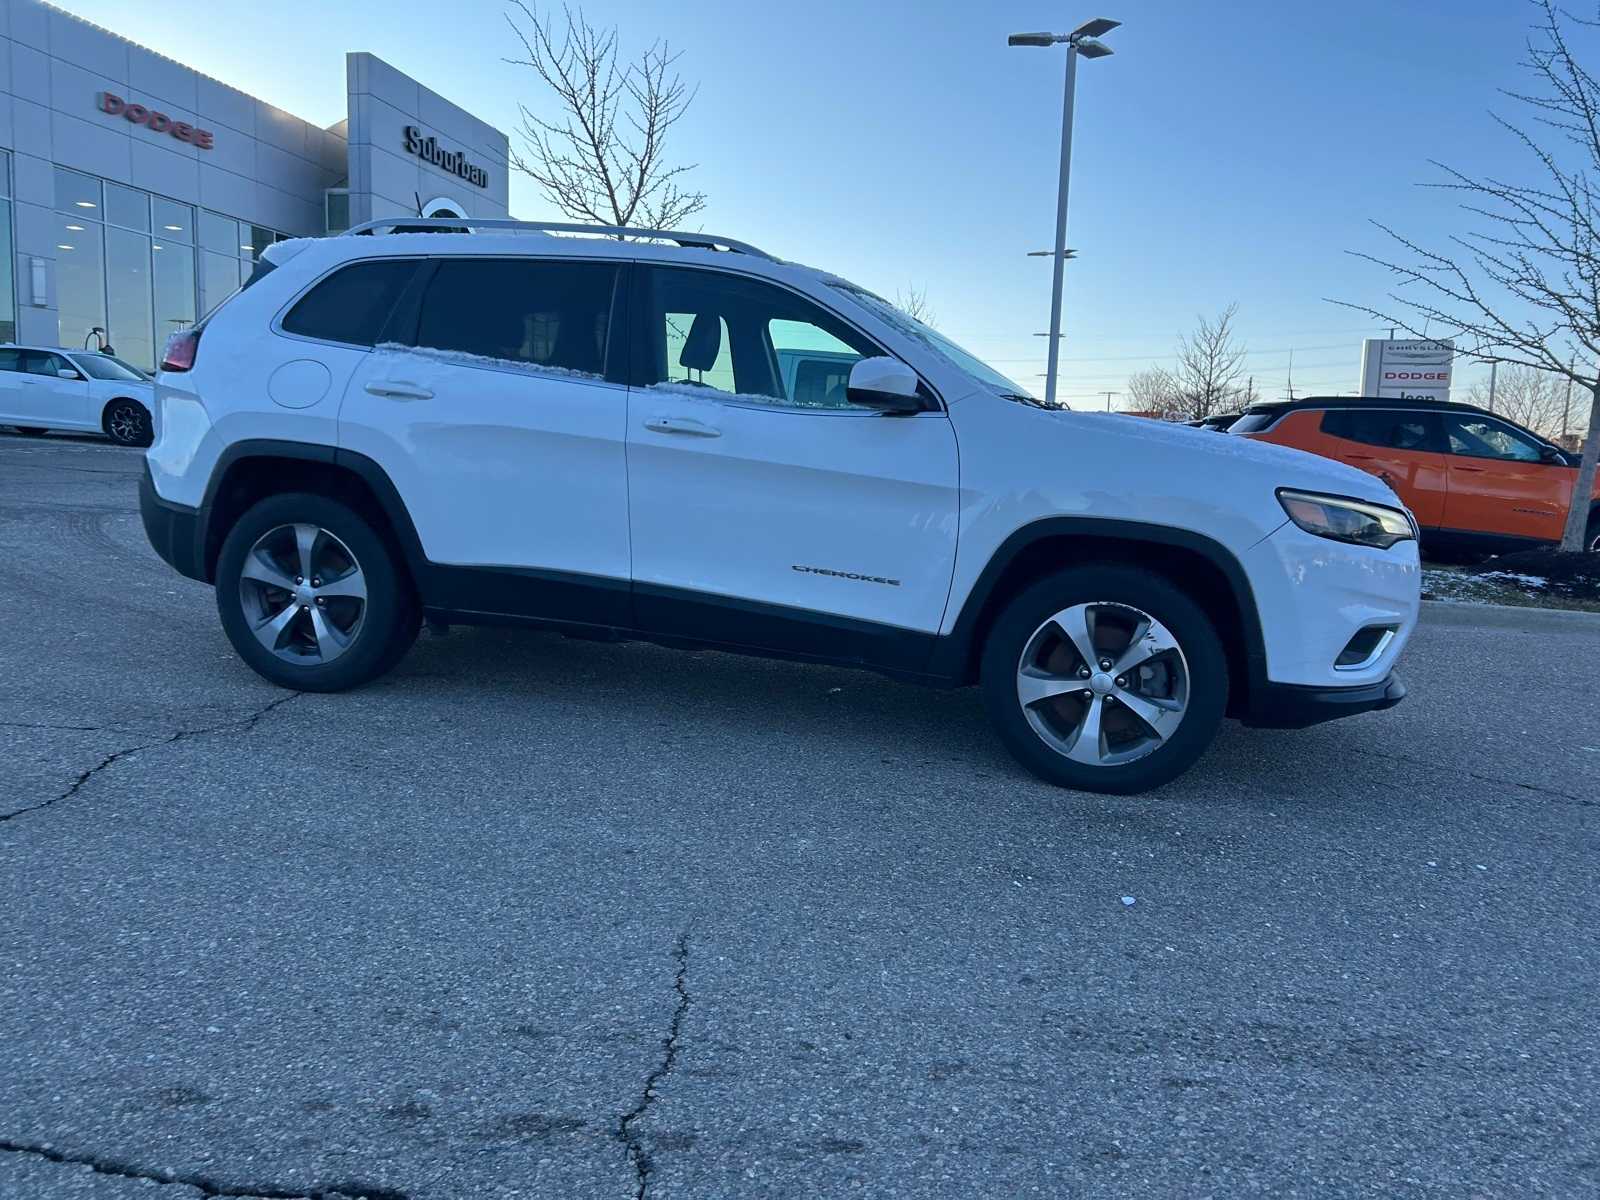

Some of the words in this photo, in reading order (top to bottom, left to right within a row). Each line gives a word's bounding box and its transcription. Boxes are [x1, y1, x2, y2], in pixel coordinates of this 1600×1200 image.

[96, 91, 214, 150] DODGE
[403, 125, 488, 189] Suburban
[1384, 372, 1449, 380] DODGE
[791, 565, 901, 586] CHEROKEE
